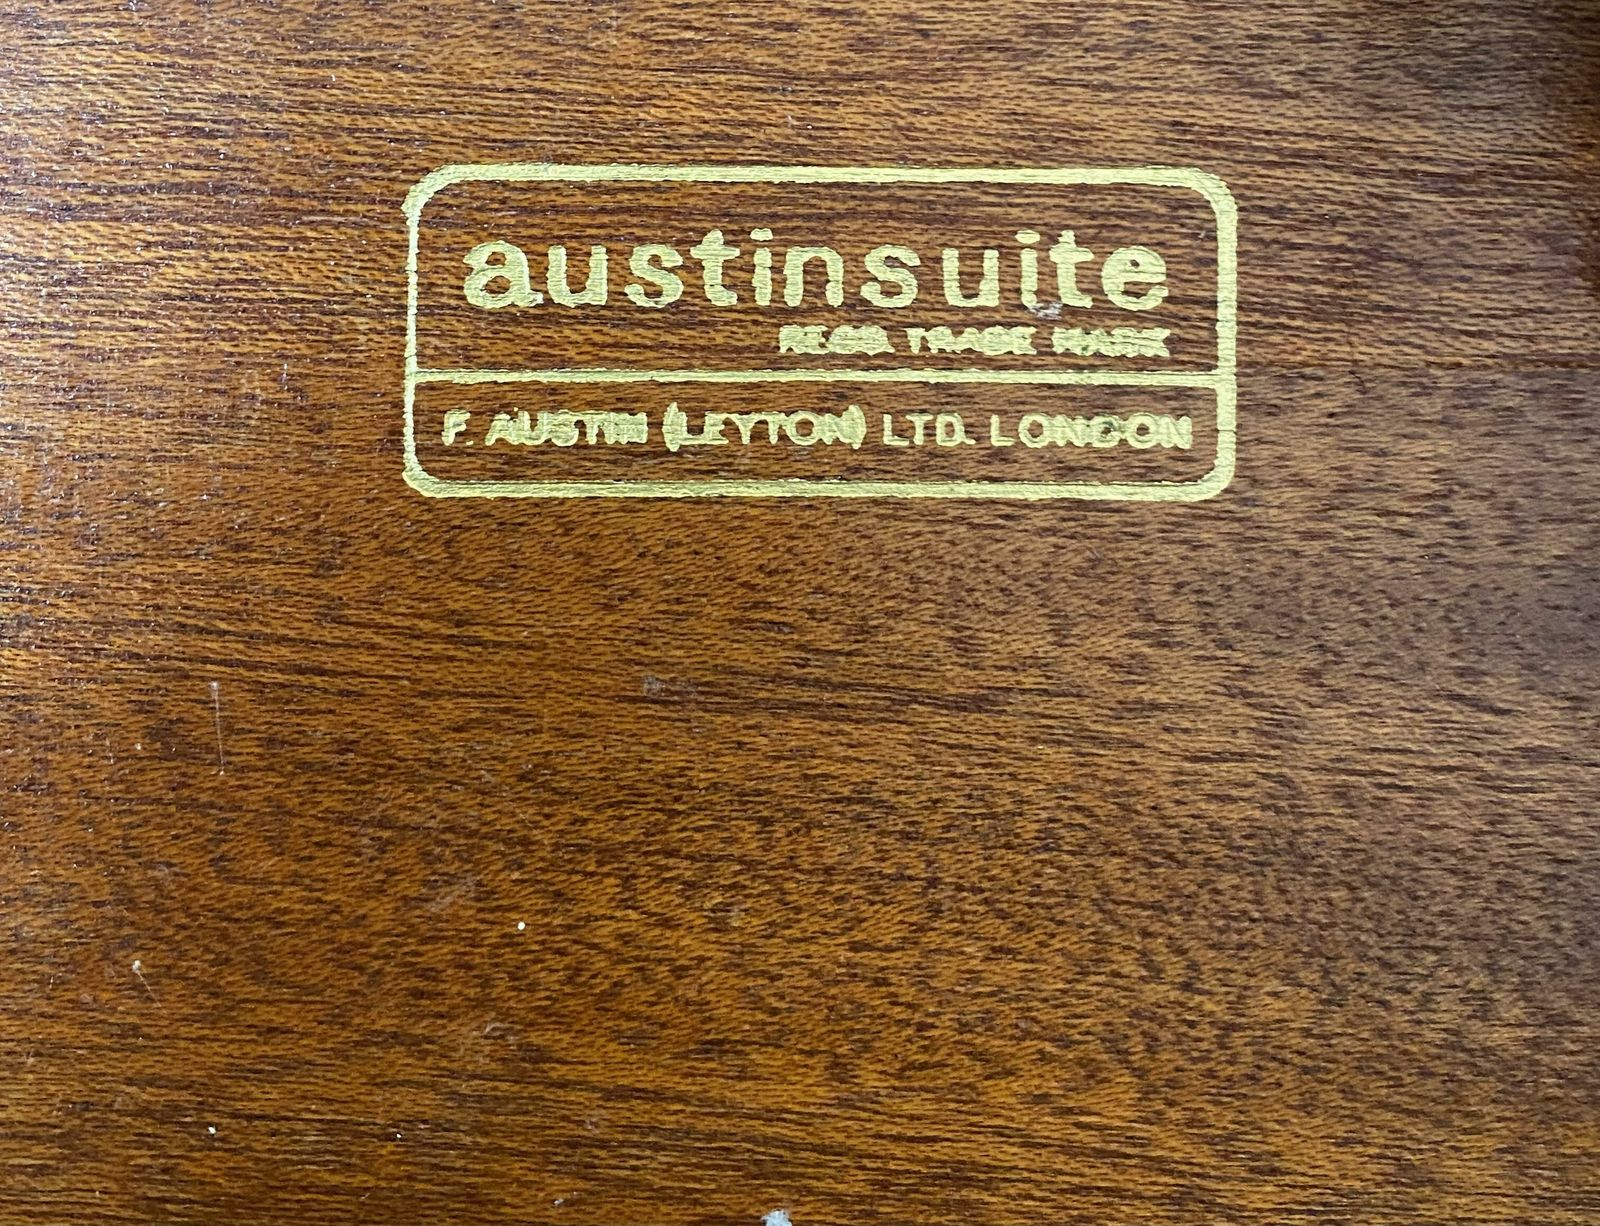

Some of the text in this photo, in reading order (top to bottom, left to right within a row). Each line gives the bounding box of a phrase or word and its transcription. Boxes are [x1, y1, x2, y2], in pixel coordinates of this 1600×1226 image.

[463, 228, 1169, 310] austinsuite
[442, 402, 1193, 452] F. AUSTIN (LEYTON) LTD. LONDON
